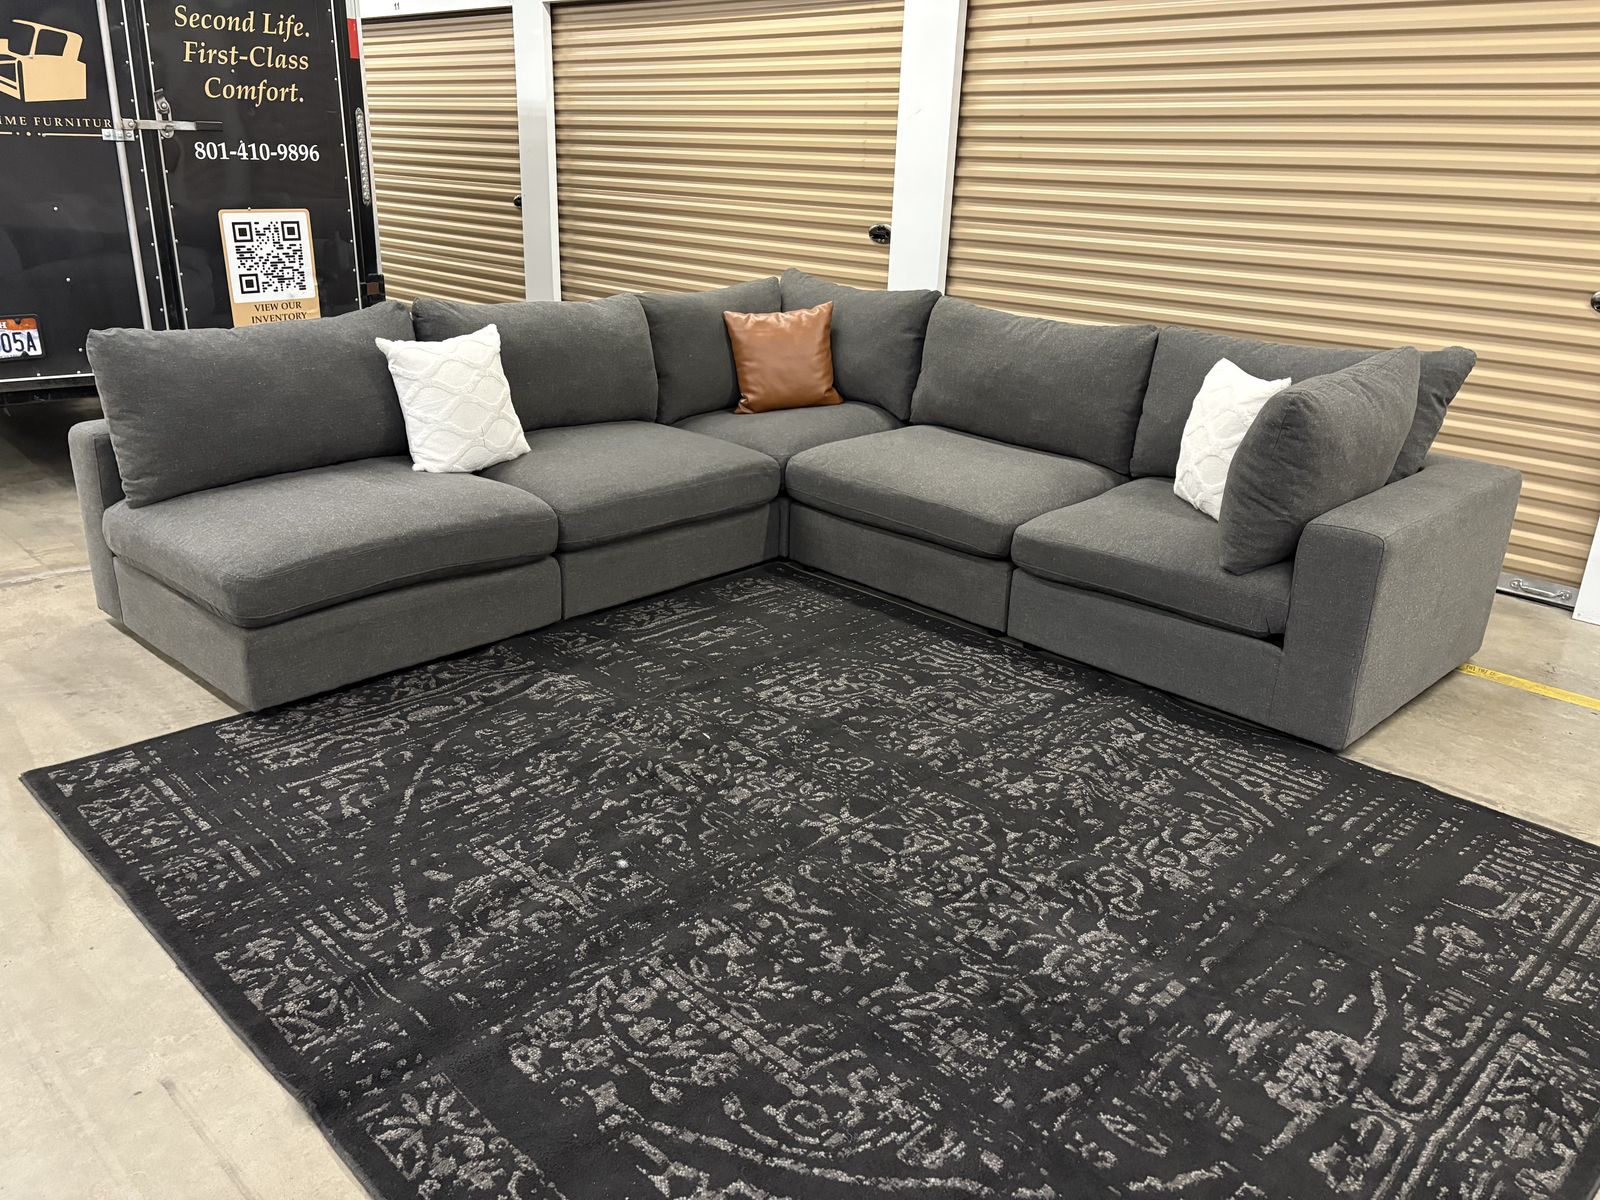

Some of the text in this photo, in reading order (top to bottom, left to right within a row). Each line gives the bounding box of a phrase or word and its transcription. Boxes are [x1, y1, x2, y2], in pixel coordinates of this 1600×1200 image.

[174, 4, 310, 43] Second Life.
[182, 40, 309, 70] First-Class
[204, 76, 304, 108] Comfort.
[33, 116, 113, 128] FURNITUR
[194, 141, 320, 162] 801-410-9896
[254, 301, 302, 312] VIEW OUR
[251, 311, 307, 324] INVENTORY
